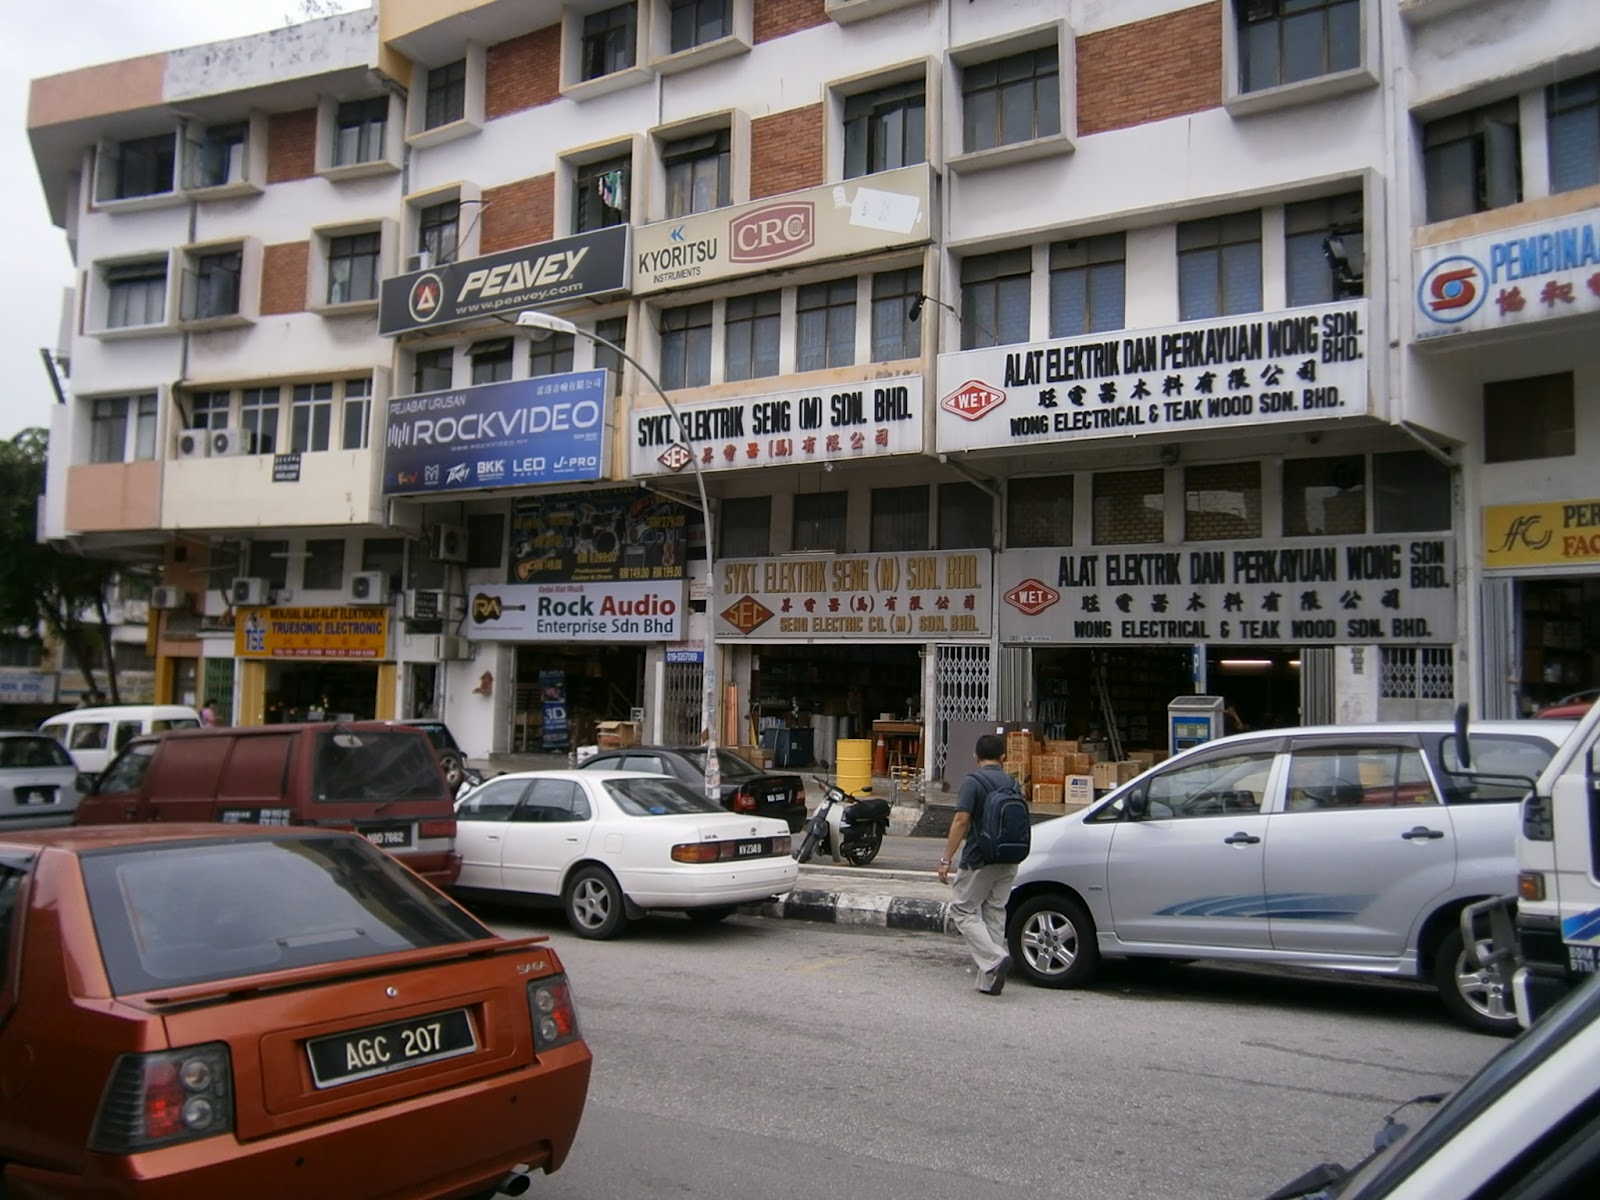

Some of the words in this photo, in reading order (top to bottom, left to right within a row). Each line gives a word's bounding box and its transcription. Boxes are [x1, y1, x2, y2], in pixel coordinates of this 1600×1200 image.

[738, 212, 806, 251] CRC
[638, 238, 718, 274] KYORITSU
[1490, 224, 1600, 284] PEMBINA
[456, 247, 589, 303] PEAVEY
[653, 266, 701, 284] INSTRUMENTS
[456, 282, 583, 315] www.peavey.com
[1322, 310, 1363, 339] SDN.
[1004, 349, 1045, 388] ALAT
[1046, 340, 1120, 383] ELEKTRIK
[1124, 335, 1157, 376] DAN
[1160, 322, 1262, 372] PERKAYUAN
[1267, 318, 1319, 359] WONG
[1322, 335, 1363, 364] BHD.
[390, 400, 426, 415] PEJABAT
[428, 395, 466, 410] URUSAN
[680, 406, 744, 444] ELEKTRIK
[752, 400, 791, 435] SENG
[799, 397, 823, 430] (M)
[830, 391, 867, 427] SDN.
[874, 386, 912, 422] BHD.
[1010, 415, 1049, 437] WONG
[1055, 406, 1146, 434] ELECTRICAL
[1148, 405, 1159, 424] &
[1164, 399, 1204, 421] TEAK
[1207, 395, 1253, 418] WOOD
[1259, 391, 1298, 413] SDN.
[1302, 386, 1345, 409] BHD.
[413, 400, 599, 446] ROCKVIDEO
[477, 460, 504, 474] BKK
[513, 457, 546, 473] LED
[553, 456, 597, 469] J-PRO
[662, 446, 692, 468] SEC
[764, 560, 827, 594] ELEKTRIK
[832, 558, 869, 592] SENG
[875, 556, 901, 593] (M)
[906, 556, 941, 590] SDN.
[945, 554, 982, 590] BHD.
[1058, 555, 1098, 588] ALAT
[1106, 552, 1182, 587] ELEKTRIK
[1190, 551, 1226, 585] DAN
[1233, 547, 1337, 584] PERKAYUAN
[1347, 545, 1401, 580] WONG
[1410, 565, 1450, 589] BHD.
[537, 595, 594, 617] Rock
[599, 594, 676, 616] Audio
[729, 601, 764, 628] SEC
[272, 622, 322, 635] TRUESONIC
[325, 622, 382, 635] ELECTRONIC
[537, 619, 607, 637] Enterprise
[611, 619, 639, 633] Sdn
[644, 618, 673, 633] Bhd
[779, 616, 808, 633] SENG
[812, 616, 863, 632] ELECTRIC
[868, 615, 887, 632] CO.
[889, 613, 913, 634] (M)
[918, 615, 948, 632] SDN.
[950, 614, 979, 632] BHD.
[1073, 621, 1112, 639] WONG
[1122, 620, 1210, 639] ELECTRICAL
[1220, 620, 1230, 638] &
[1240, 619, 1280, 639] TEAK
[1292, 619, 1336, 639] WOOD
[1348, 618, 1385, 638] SDN.
[1392, 618, 1432, 637] BHD.
[1194, 653, 1199, 674] P
[544, 707, 566, 720] 3D
[346, 1035, 390, 1071] AGC
[401, 1023, 441, 1058] 207
